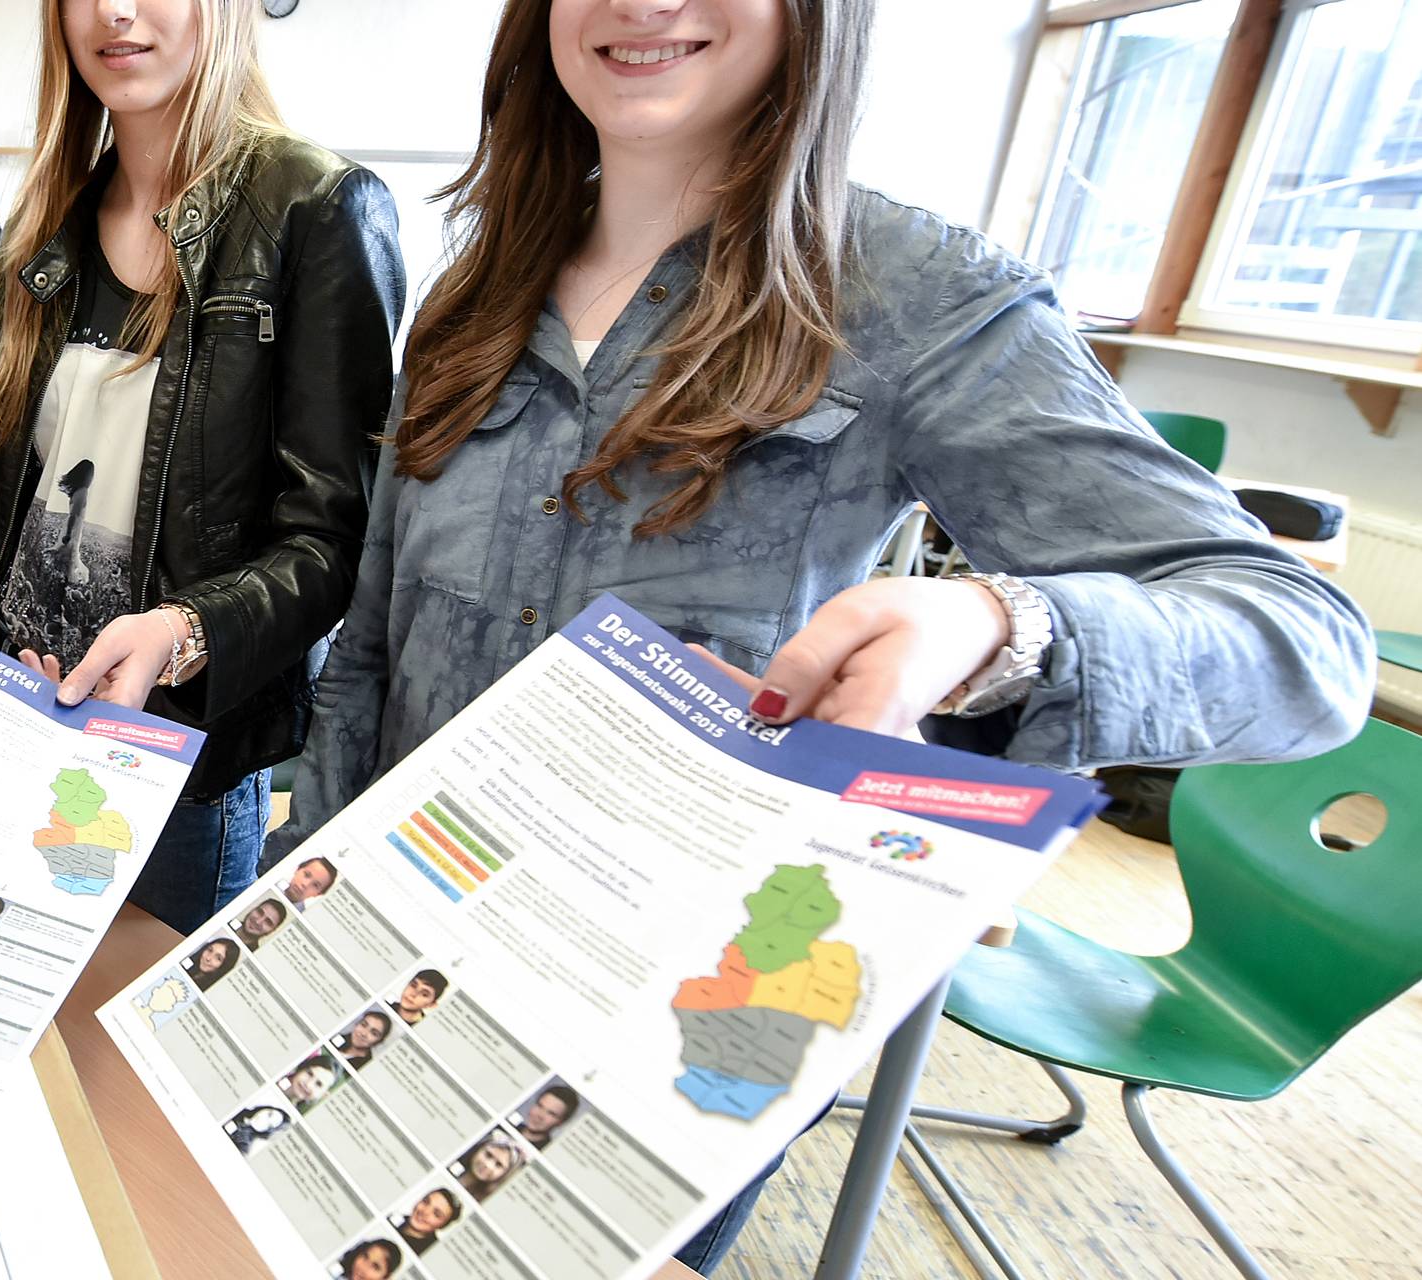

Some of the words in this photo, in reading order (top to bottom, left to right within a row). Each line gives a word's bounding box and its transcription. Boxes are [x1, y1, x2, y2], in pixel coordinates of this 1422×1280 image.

[582, 633, 605, 649] zur
[601, 644, 693, 716] Jugendratswahl
[689, 710, 727, 738] 2015
[597, 613, 643, 647] Der
[638, 641, 792, 747] Stimmzettel
[89, 720, 116, 732] Jetzt
[118, 726, 179, 744] mitmachen!
[856, 777, 904, 796] Jetzt
[908, 784, 1031, 811] mitmachen!
